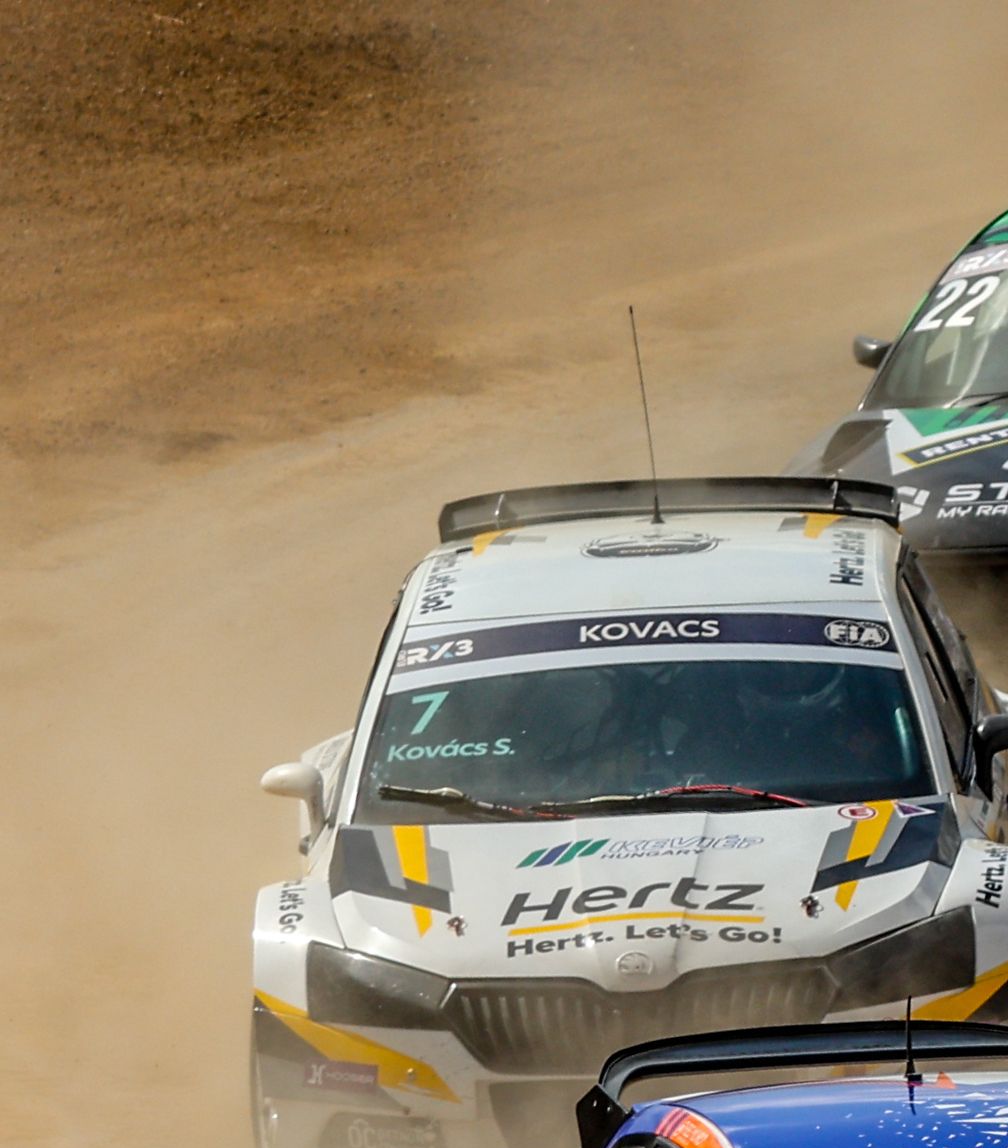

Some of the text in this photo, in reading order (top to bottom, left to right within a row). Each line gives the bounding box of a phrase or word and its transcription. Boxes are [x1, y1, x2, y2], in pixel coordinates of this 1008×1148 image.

[914, 275, 1001, 332] 22
[937, 505, 973, 520] MY
[579, 619, 721, 643] KOVACS
[828, 622, 885, 644] FIA
[406, 638, 474, 666] RX3
[410, 690, 450, 736] 7
[386, 737, 516, 763] Kovács S.
[600, 849, 706, 860] HUNGARY
[500, 876, 766, 927] Hertz
[506, 922, 783, 958] Hertz. Let's Go!
